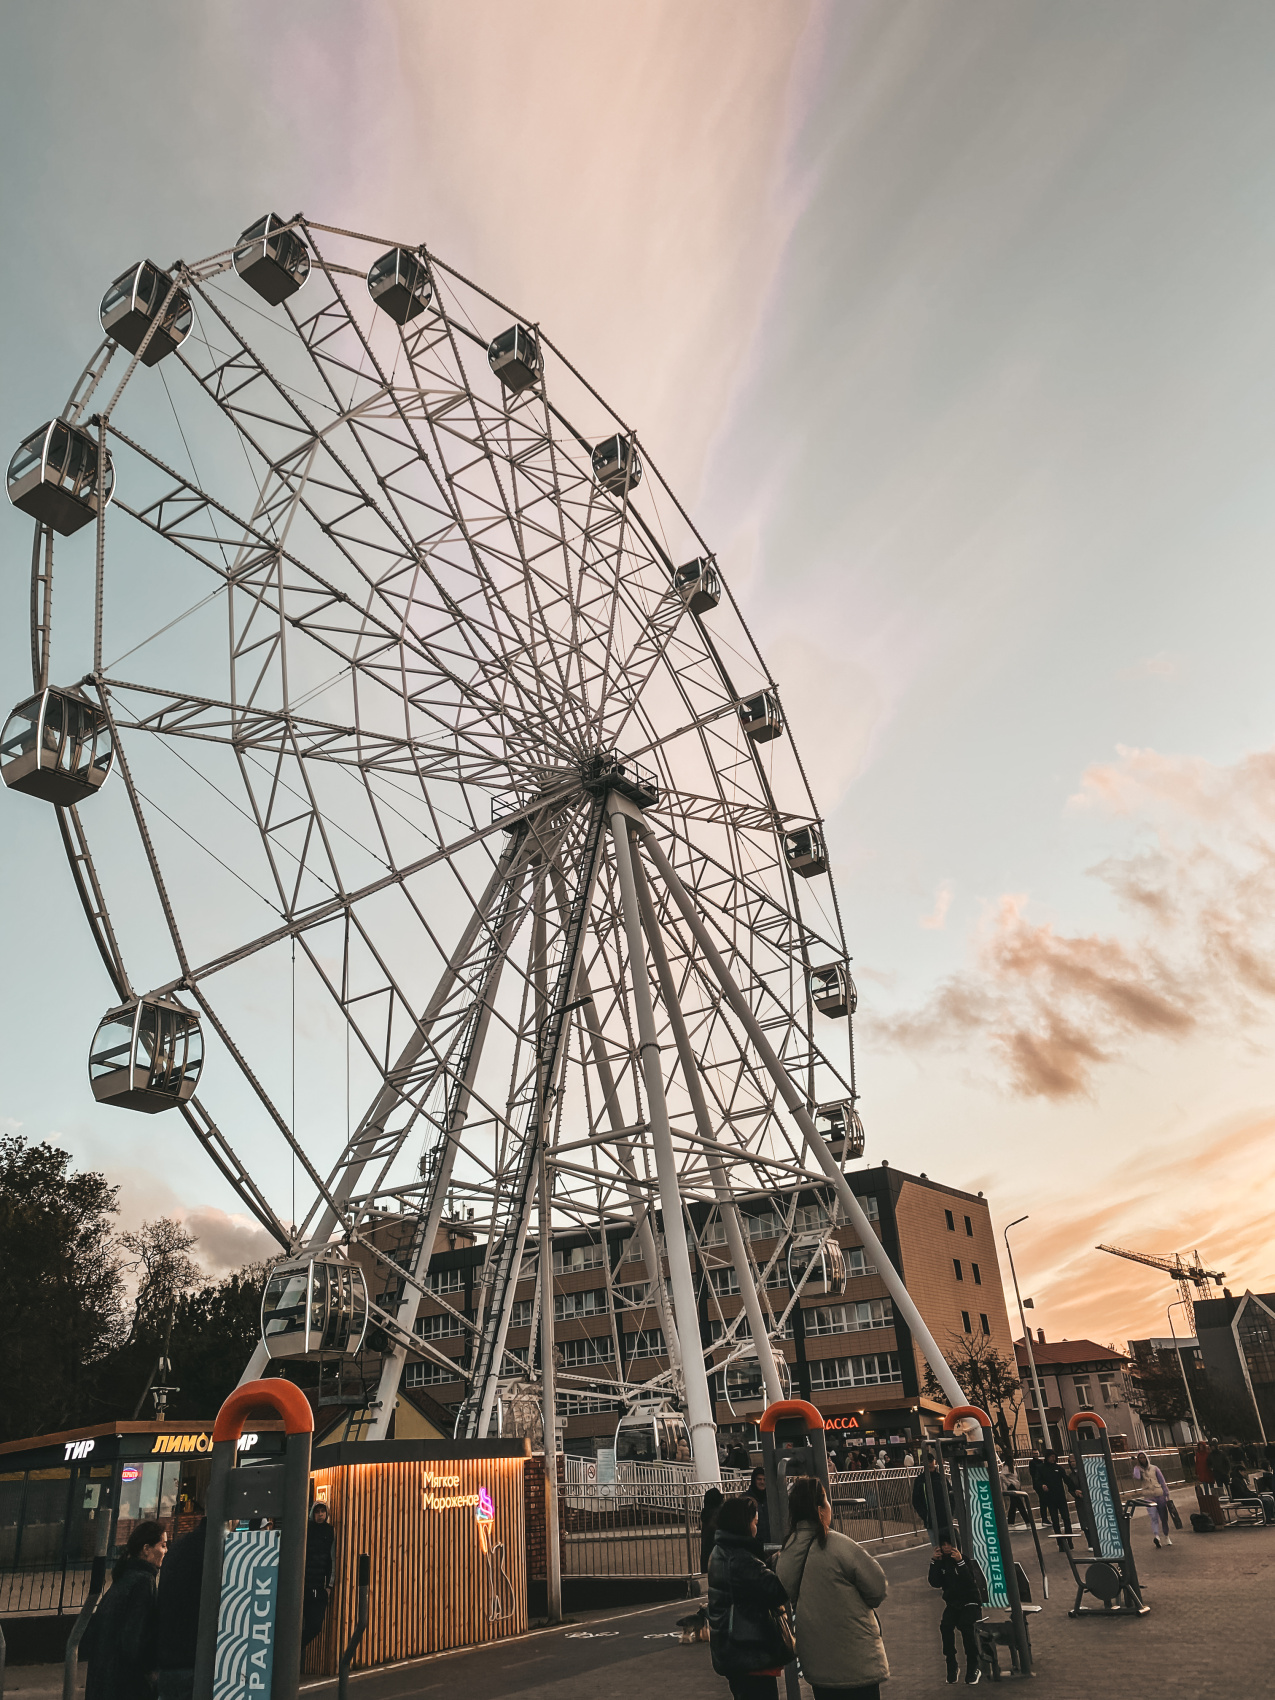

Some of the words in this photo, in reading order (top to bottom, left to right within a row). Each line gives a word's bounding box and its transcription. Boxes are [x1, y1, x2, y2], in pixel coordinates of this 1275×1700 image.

[823, 1417, 859, 1430] АССА
[64, 1439, 95, 1461] ТИР
[237, 1433, 259, 1451] ИР
[424, 1471, 459, 1488] Мягкое
[424, 1492, 479, 1513] Мороженое
[1099, 1469, 1121, 1547] ЗЕЛЕНОГРАДСК
[979, 1485, 1004, 1590] ЗЕЛЕНОГРАДСК
